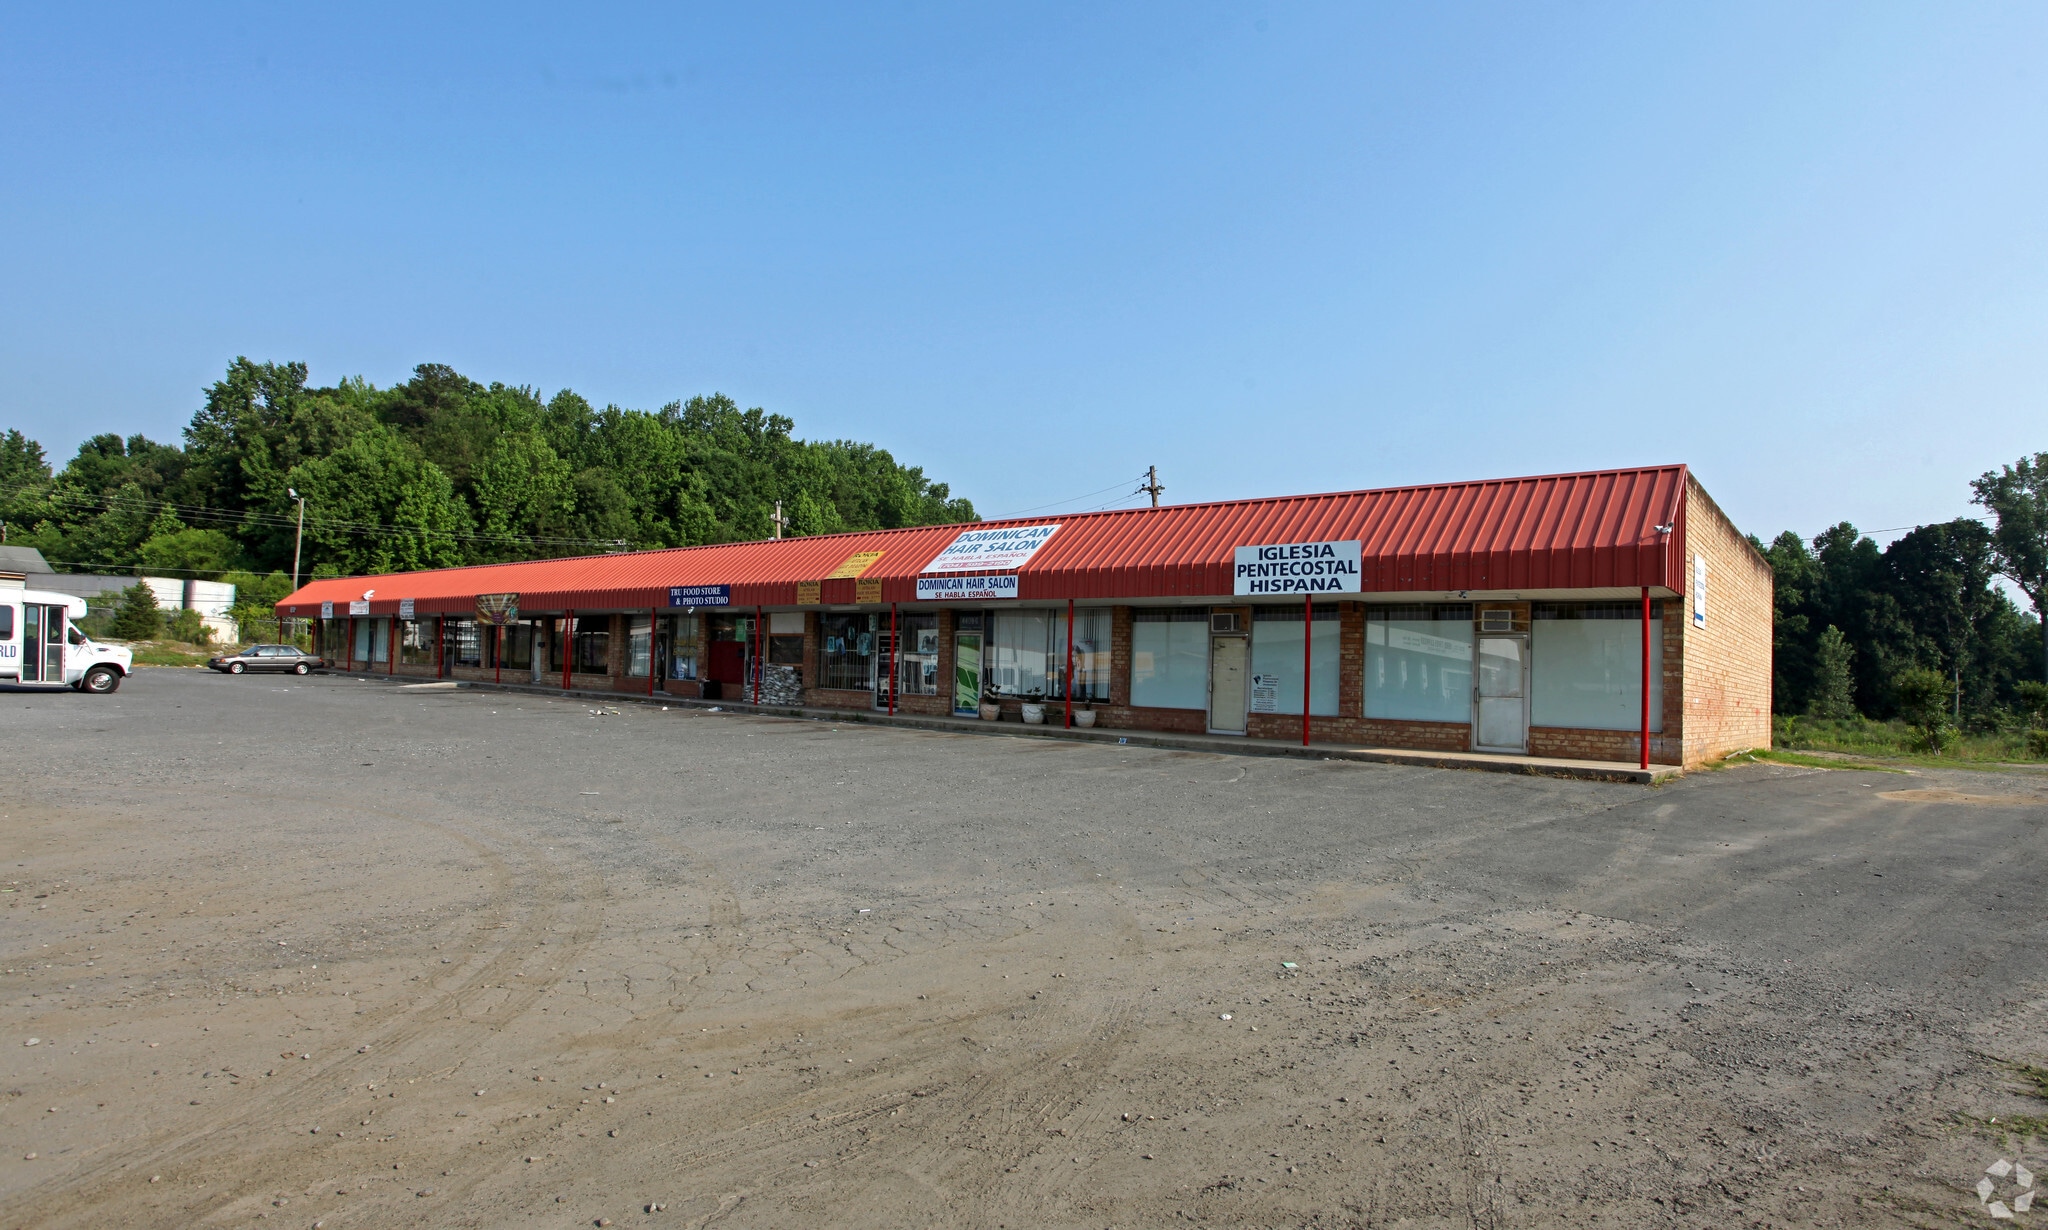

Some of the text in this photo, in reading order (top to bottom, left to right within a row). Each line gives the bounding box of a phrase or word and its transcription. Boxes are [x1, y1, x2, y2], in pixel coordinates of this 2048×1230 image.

[956, 527, 1055, 543] DOMINICAN
[943, 539, 1044, 555] HAIR SALON
[1258, 544, 1335, 561] IGLESIA
[985, 551, 1027, 559] ESPAÑOL
[1237, 560, 1358, 578] PENTECOSTAL
[670, 587, 721, 596] TRU FOOD STORE
[918, 577, 1016, 591] DOMINICAN HAIR SALON
[1250, 577, 1343, 593] HISPANA
[675, 596, 729, 605] & PHOTO STUDIO
[945, 590, 966, 598] HABLA
[968, 589, 997, 598] ESPAÑOL
